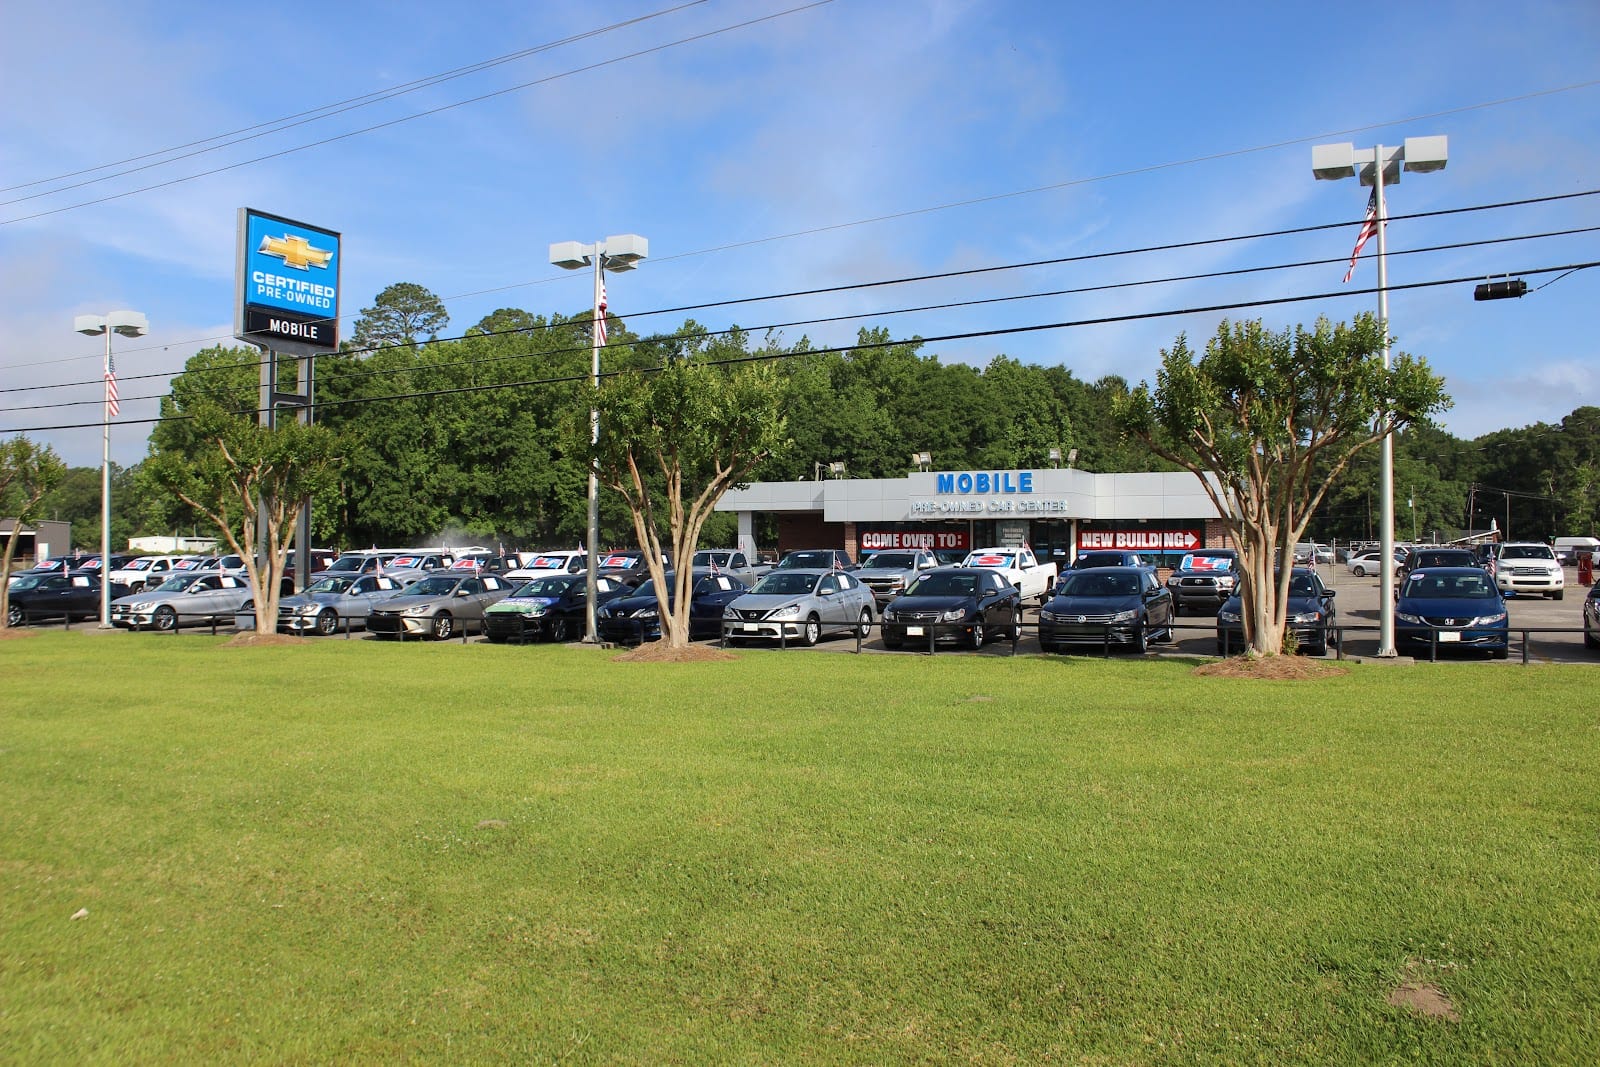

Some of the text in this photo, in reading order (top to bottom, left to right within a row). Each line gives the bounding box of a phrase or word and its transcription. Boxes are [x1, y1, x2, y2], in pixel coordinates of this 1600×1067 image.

[252, 271, 335, 298] CERTIFIED
[257, 285, 330, 309] PRE-OWNED
[269, 318, 318, 339] MOBILE
[937, 472, 1033, 494] MOBILE
[911, 500, 1067, 514] PRE-OWNED CAR CENTER
[862, 533, 962, 547] COME OVER TO:
[1081, 532, 1184, 548] NEW BUILDING
